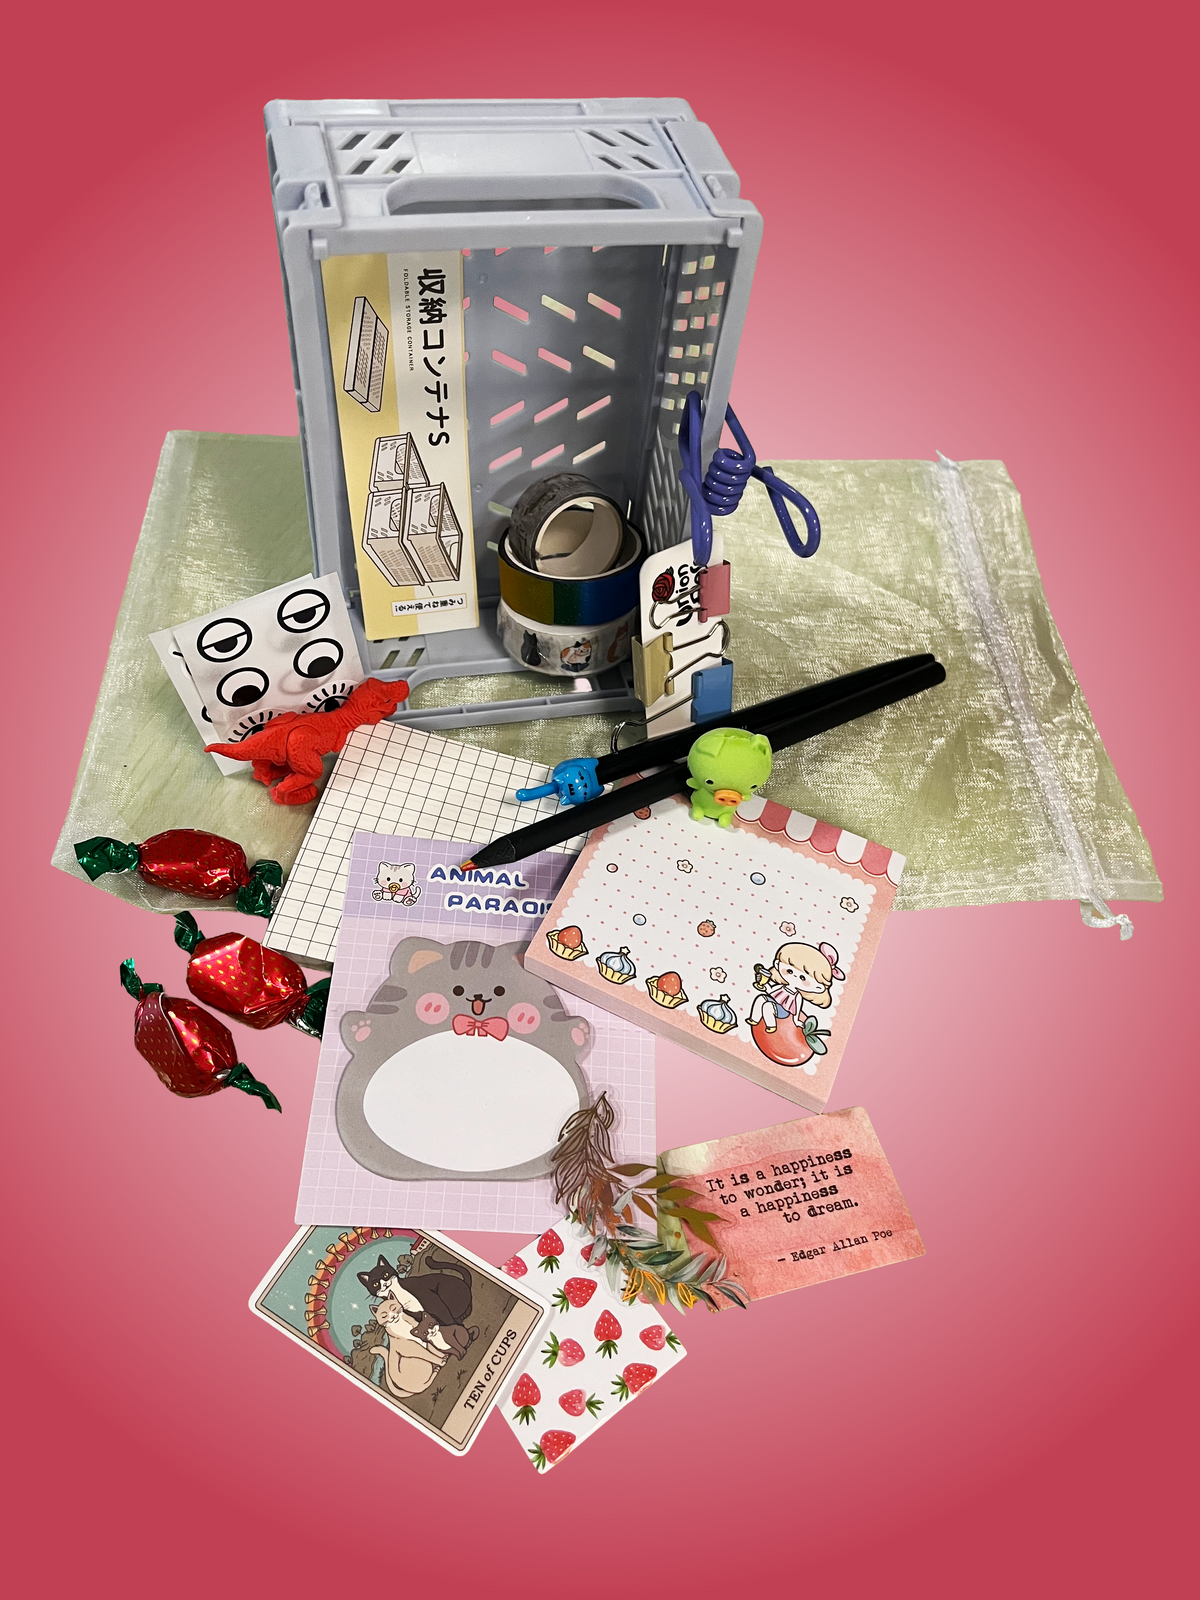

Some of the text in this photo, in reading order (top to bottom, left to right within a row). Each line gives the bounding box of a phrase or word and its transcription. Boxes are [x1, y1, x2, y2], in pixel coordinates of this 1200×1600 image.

[417, 268, 450, 447] 収納コンテナS
[430, 866, 526, 887] ANIMAL
[447, 895, 553, 915] PARADI
[706, 1148, 852, 1193] It is a happiness
[719, 1164, 853, 1205] to wonder; it is
[740, 1184, 839, 1218] a happiness
[782, 1198, 859, 1224] to dream.
[790, 1246, 826, 1263] Edgar
[832, 1234, 869, 1252] Allan
[871, 1229, 893, 1241] Poe
[463, 1329, 517, 1410] TEN of CUPS
